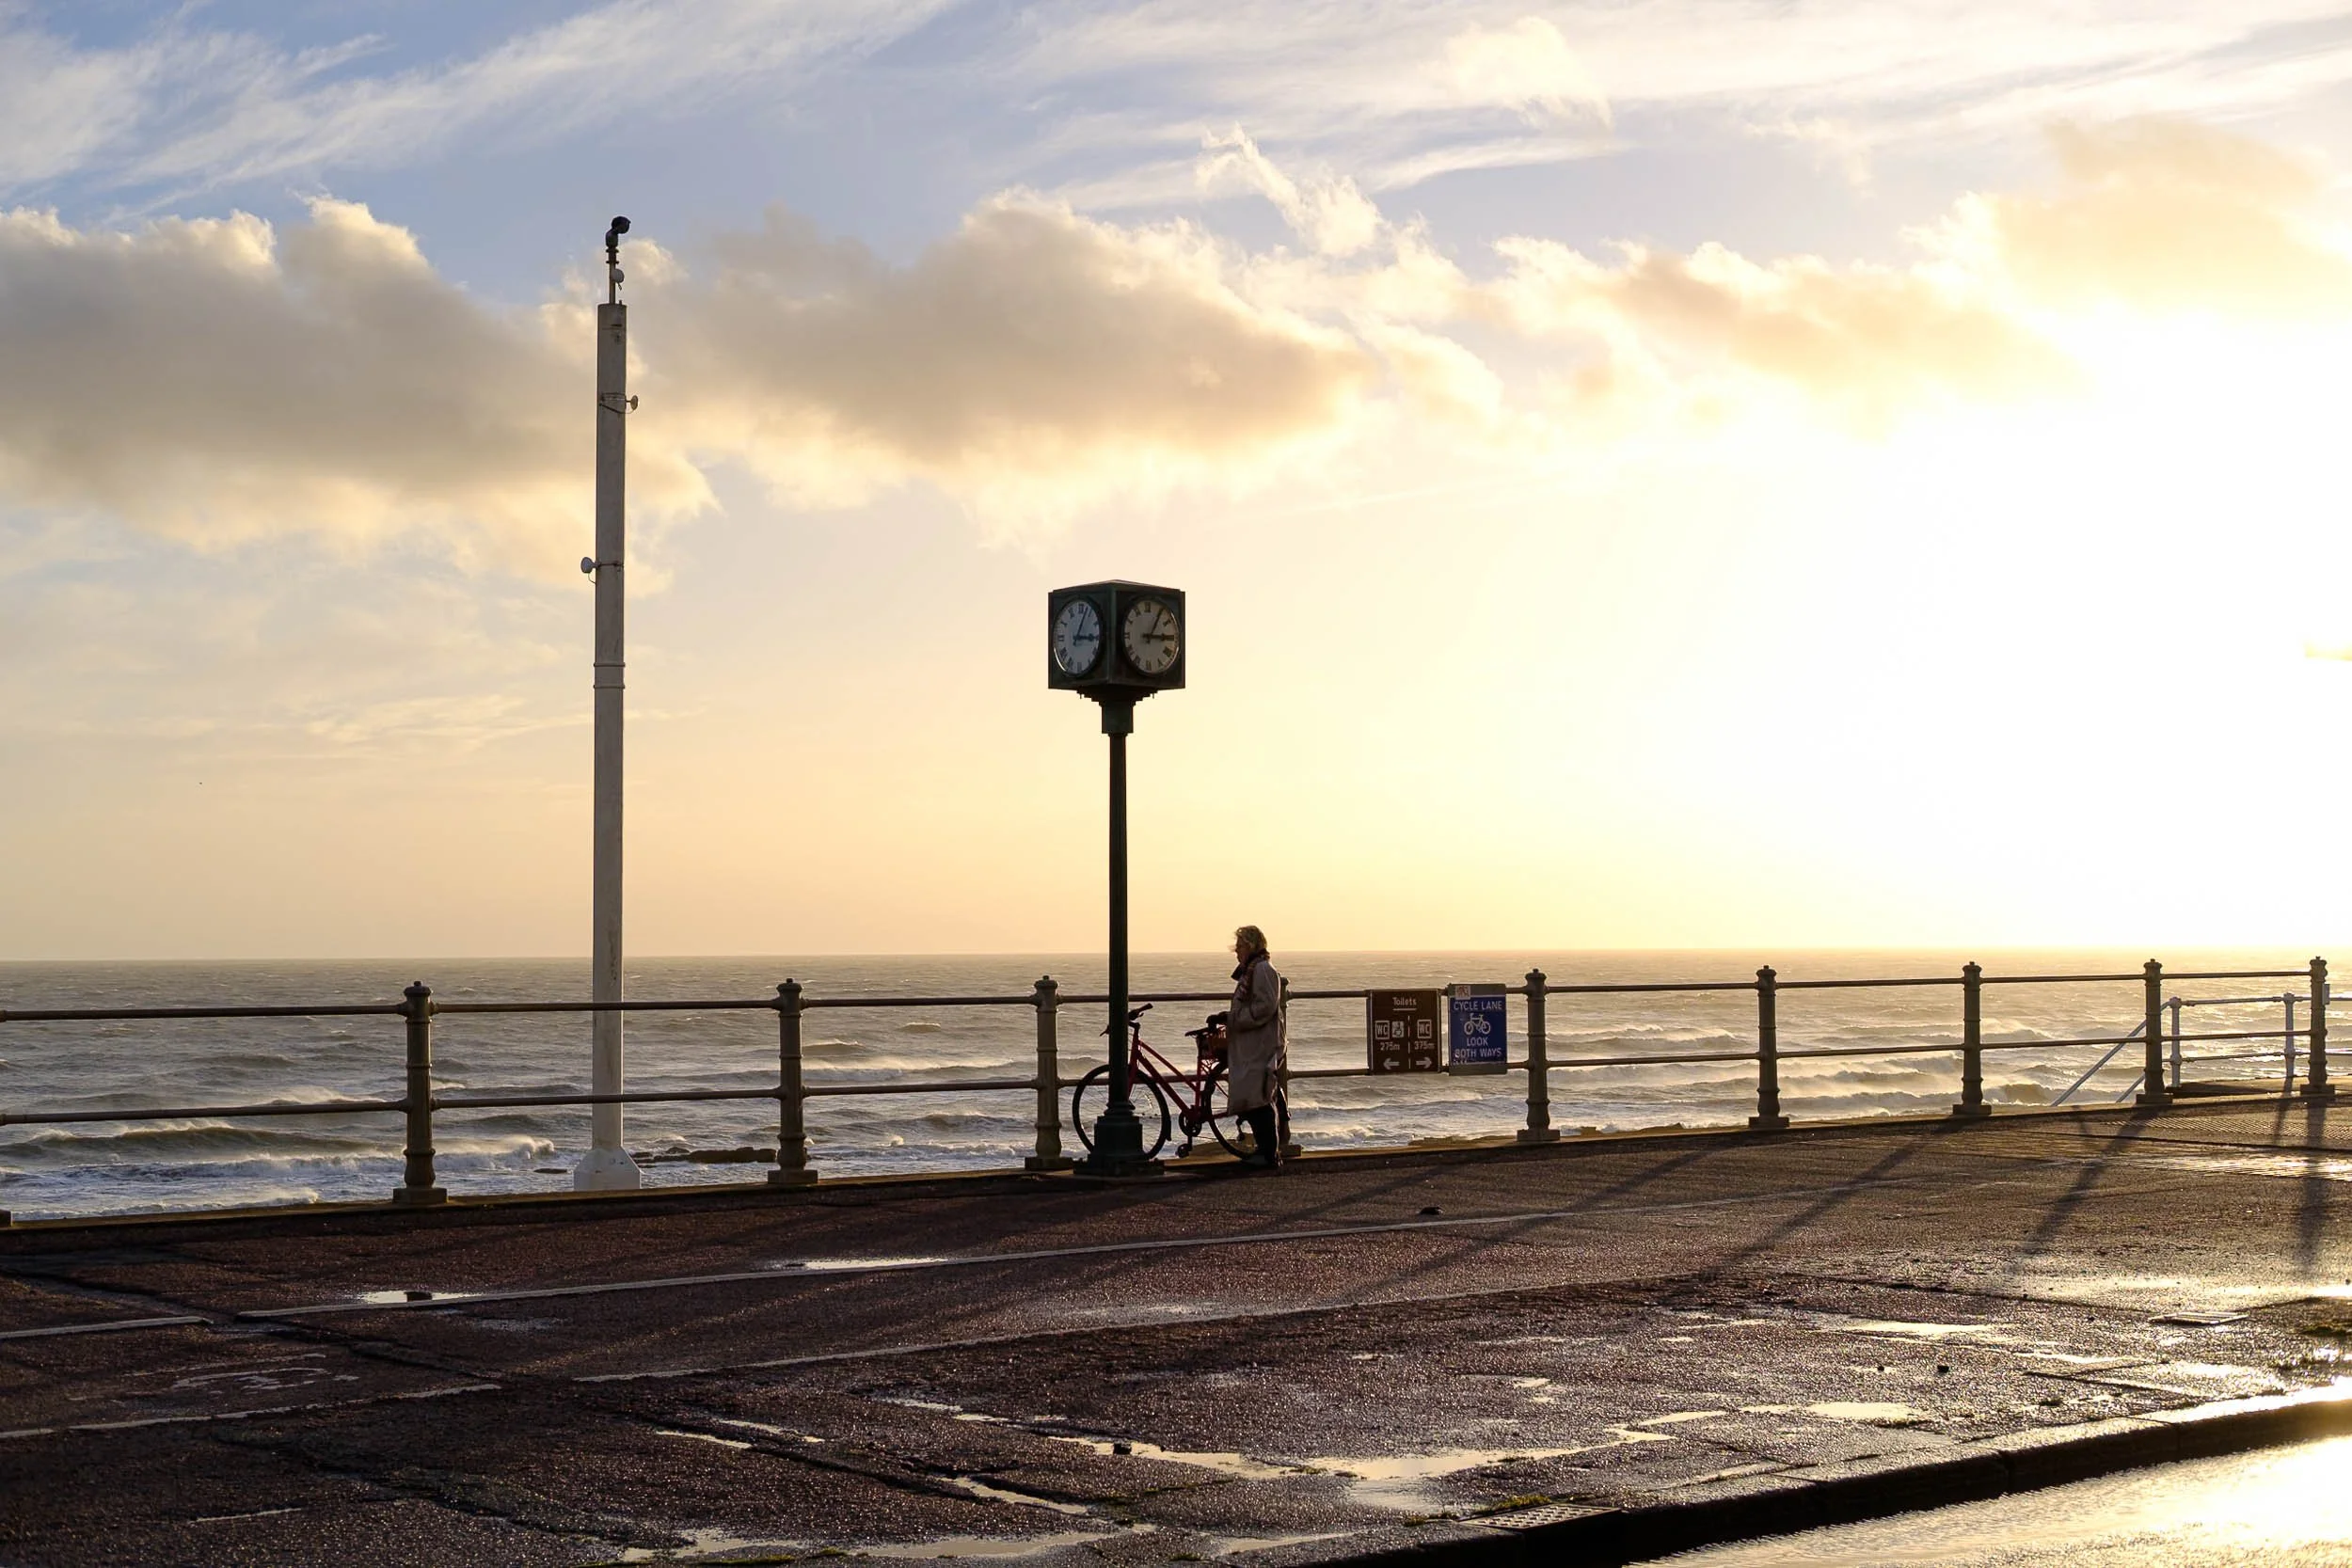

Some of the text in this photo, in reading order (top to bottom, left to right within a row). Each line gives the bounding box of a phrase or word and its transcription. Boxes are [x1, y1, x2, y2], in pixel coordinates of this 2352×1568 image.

[1392, 997, 1417, 1006] Toilets
[1454, 1001, 1502, 1010] CYCLE LANE
[1377, 1024, 1389, 1035] WC
[1419, 1022, 1430, 1034] WC
[1380, 1042, 1400, 1051] 275m
[1414, 1040, 1435, 1050] 375m
[1466, 1037, 1489, 1047] LOOK
[1454, 1048, 1502, 1058] BOTH WAYS
